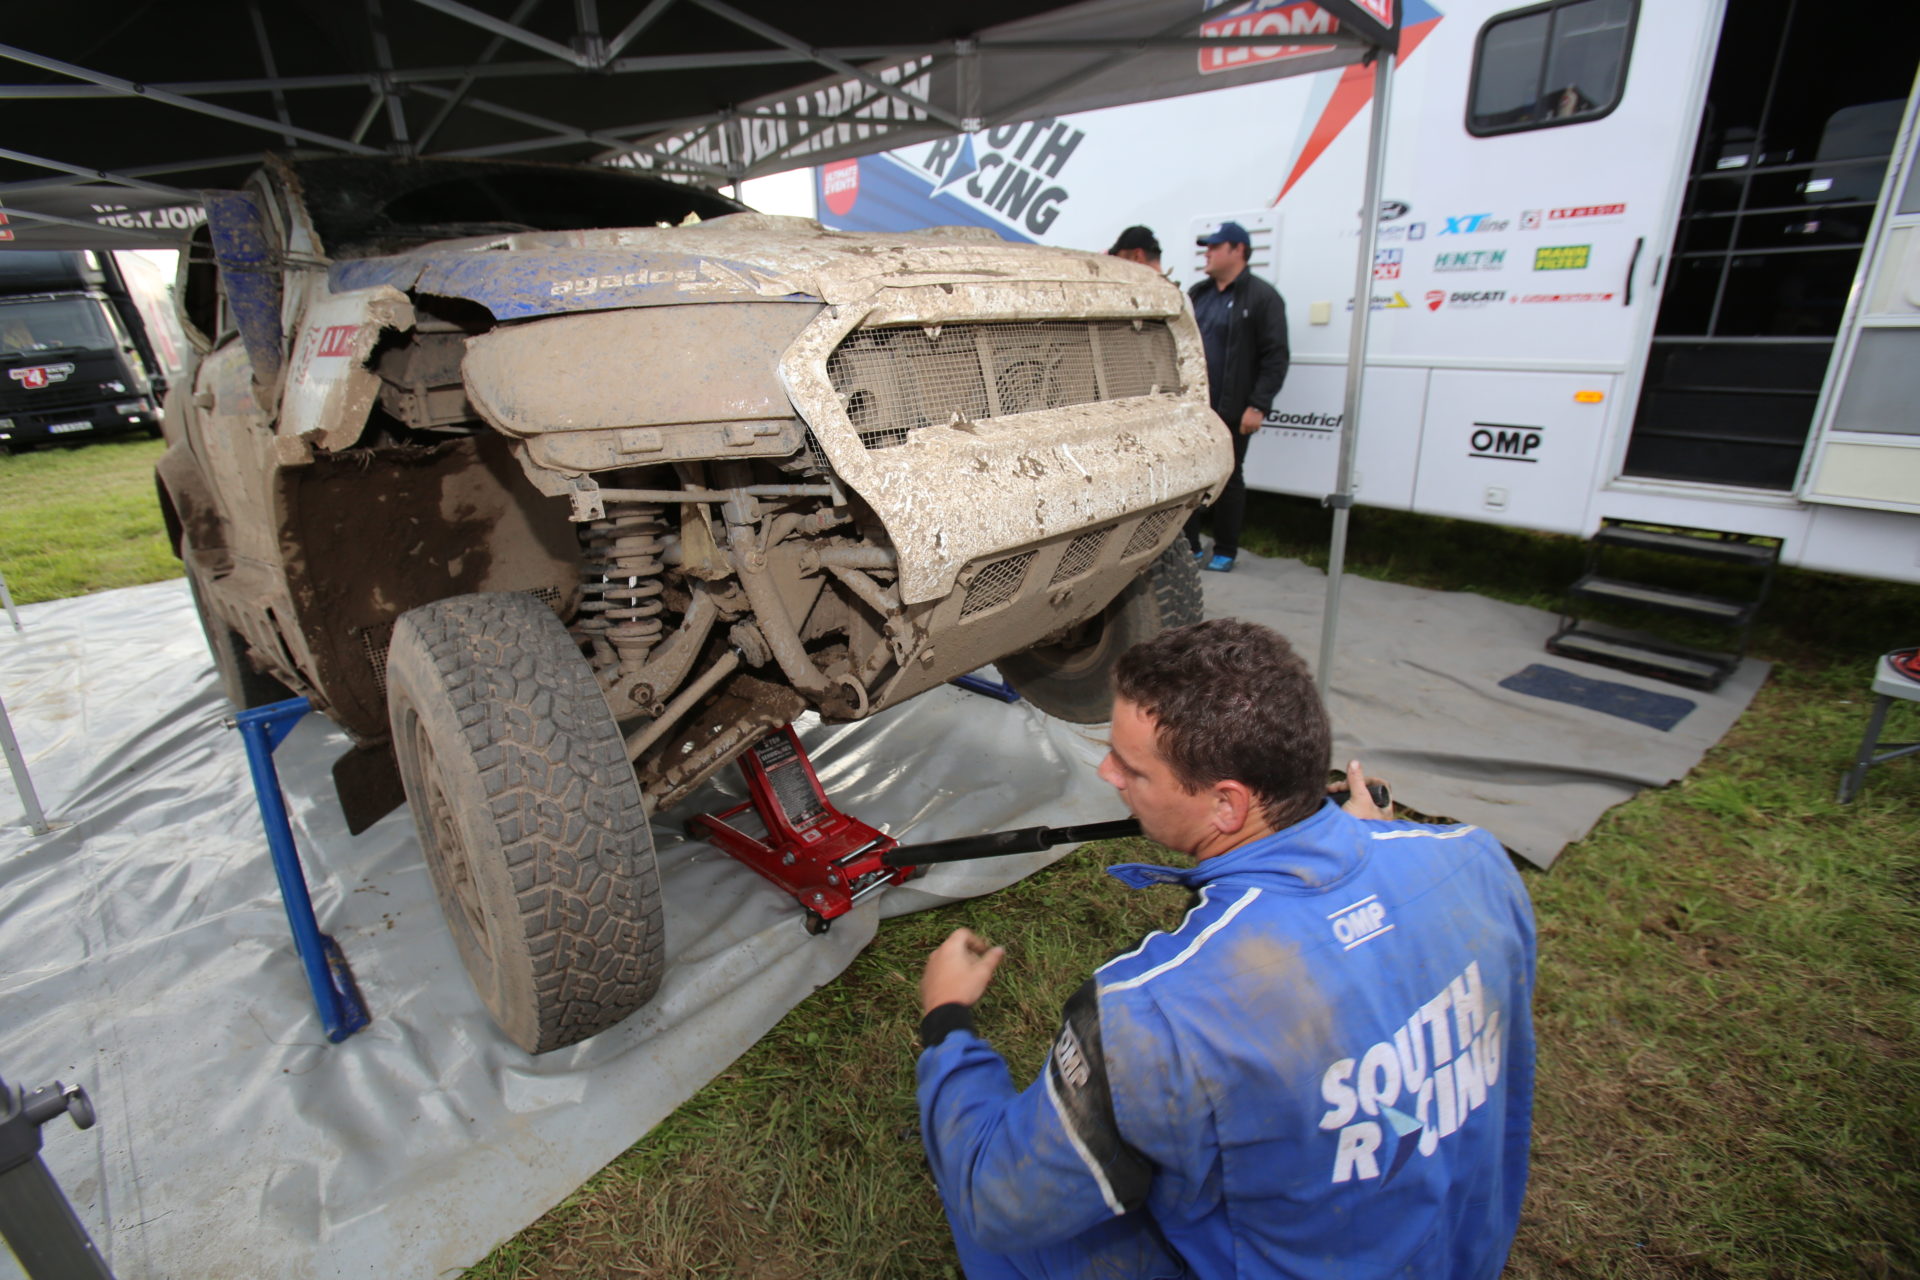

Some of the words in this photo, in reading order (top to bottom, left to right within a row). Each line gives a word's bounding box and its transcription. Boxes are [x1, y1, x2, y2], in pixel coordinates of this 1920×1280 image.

[824, 176, 858, 196] EVENTS
[1536, 245, 1590, 257] MANN
[1534, 256, 1588, 269] FILTER
[1449, 290, 1506, 303] DUCATI
[1470, 429, 1542, 456] OMP
[1332, 902, 1386, 944] OMP
[1318, 960, 1486, 1130] SOUTH
